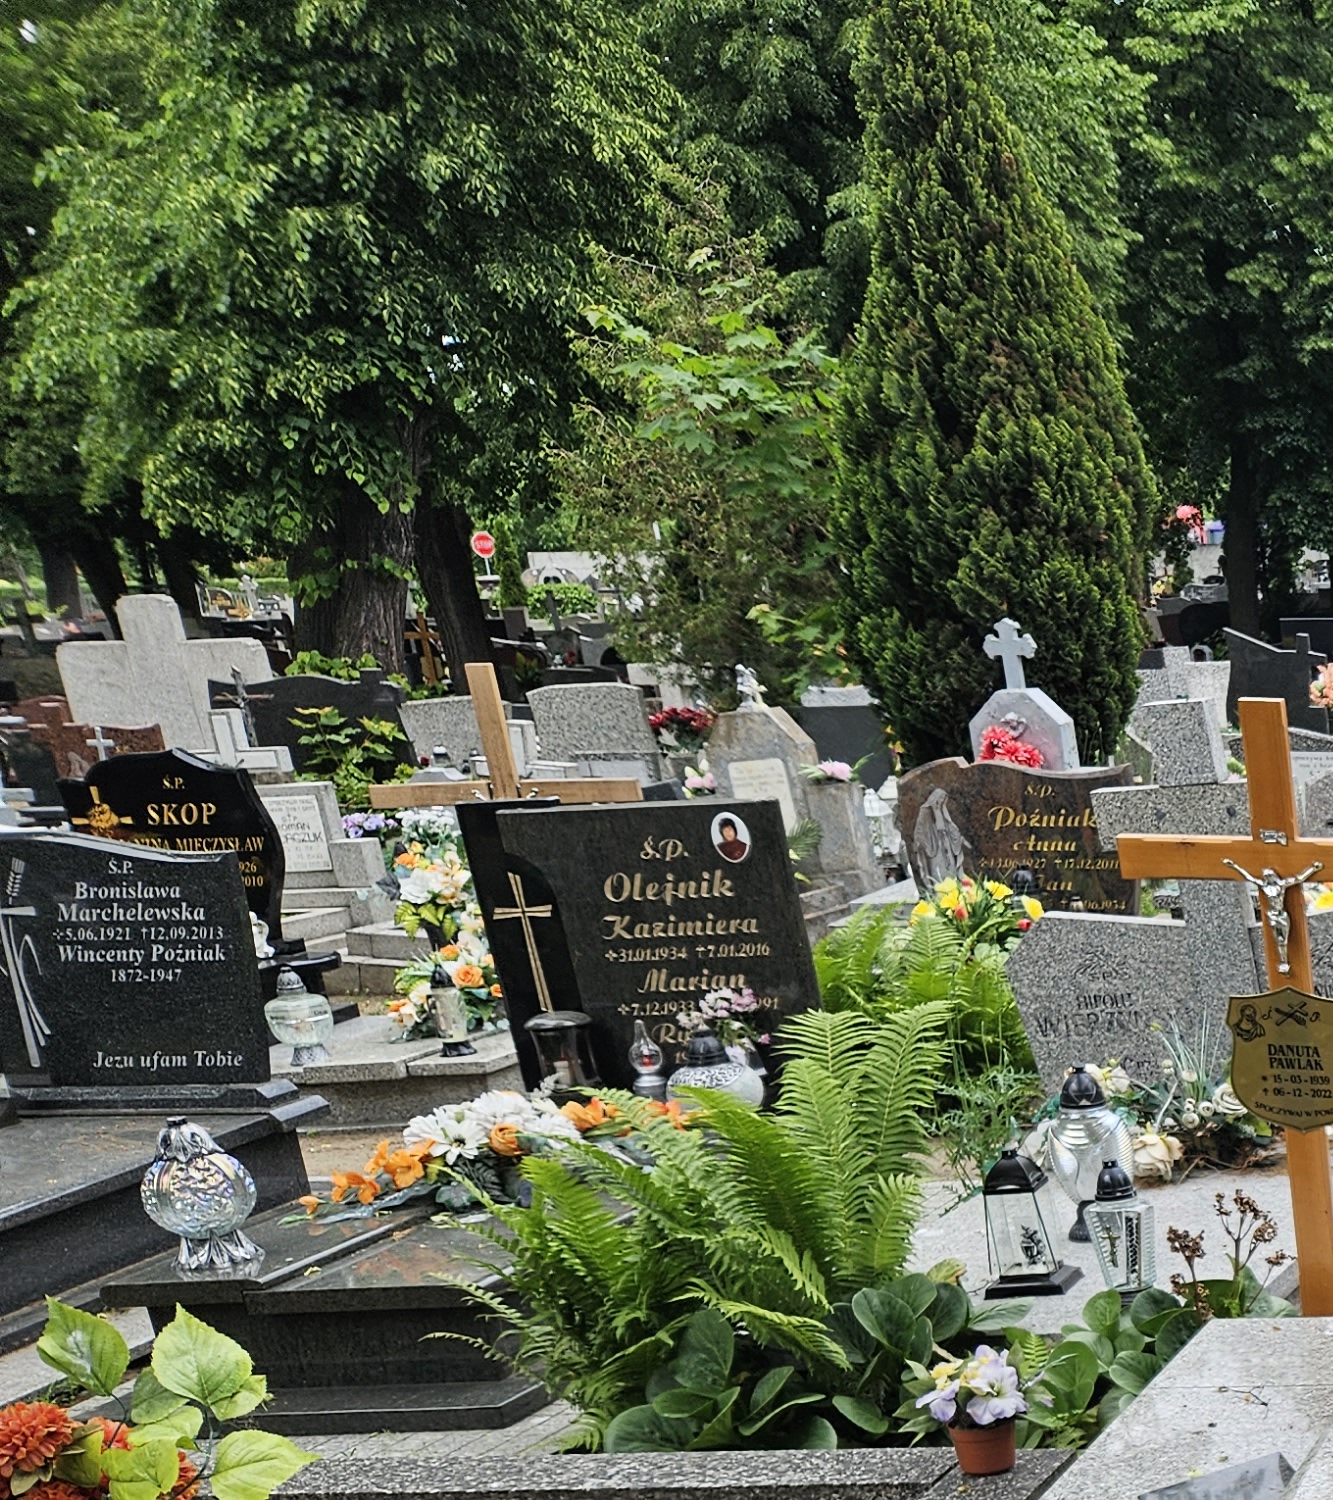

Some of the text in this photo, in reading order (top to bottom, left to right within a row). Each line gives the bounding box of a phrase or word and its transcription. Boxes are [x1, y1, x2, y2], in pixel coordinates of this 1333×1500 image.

[147, 802, 217, 826] SKOP
[988, 805, 1097, 831] Poźniak
[1013, 834, 1077, 852] Anna
[604, 869, 735, 907] Olejnik
[57, 902, 205, 922] Marchelewska
[602, 913, 759, 940] Kazimiera
[57, 943, 226, 966] Wincenty Poźniak
[638, 969, 748, 993] Marian
[93, 1050, 243, 1071] Jezu ufam Tobie
[1267, 1044, 1321, 1058] DANUTA
[1269, 1057, 1324, 1071] PAWLAK
